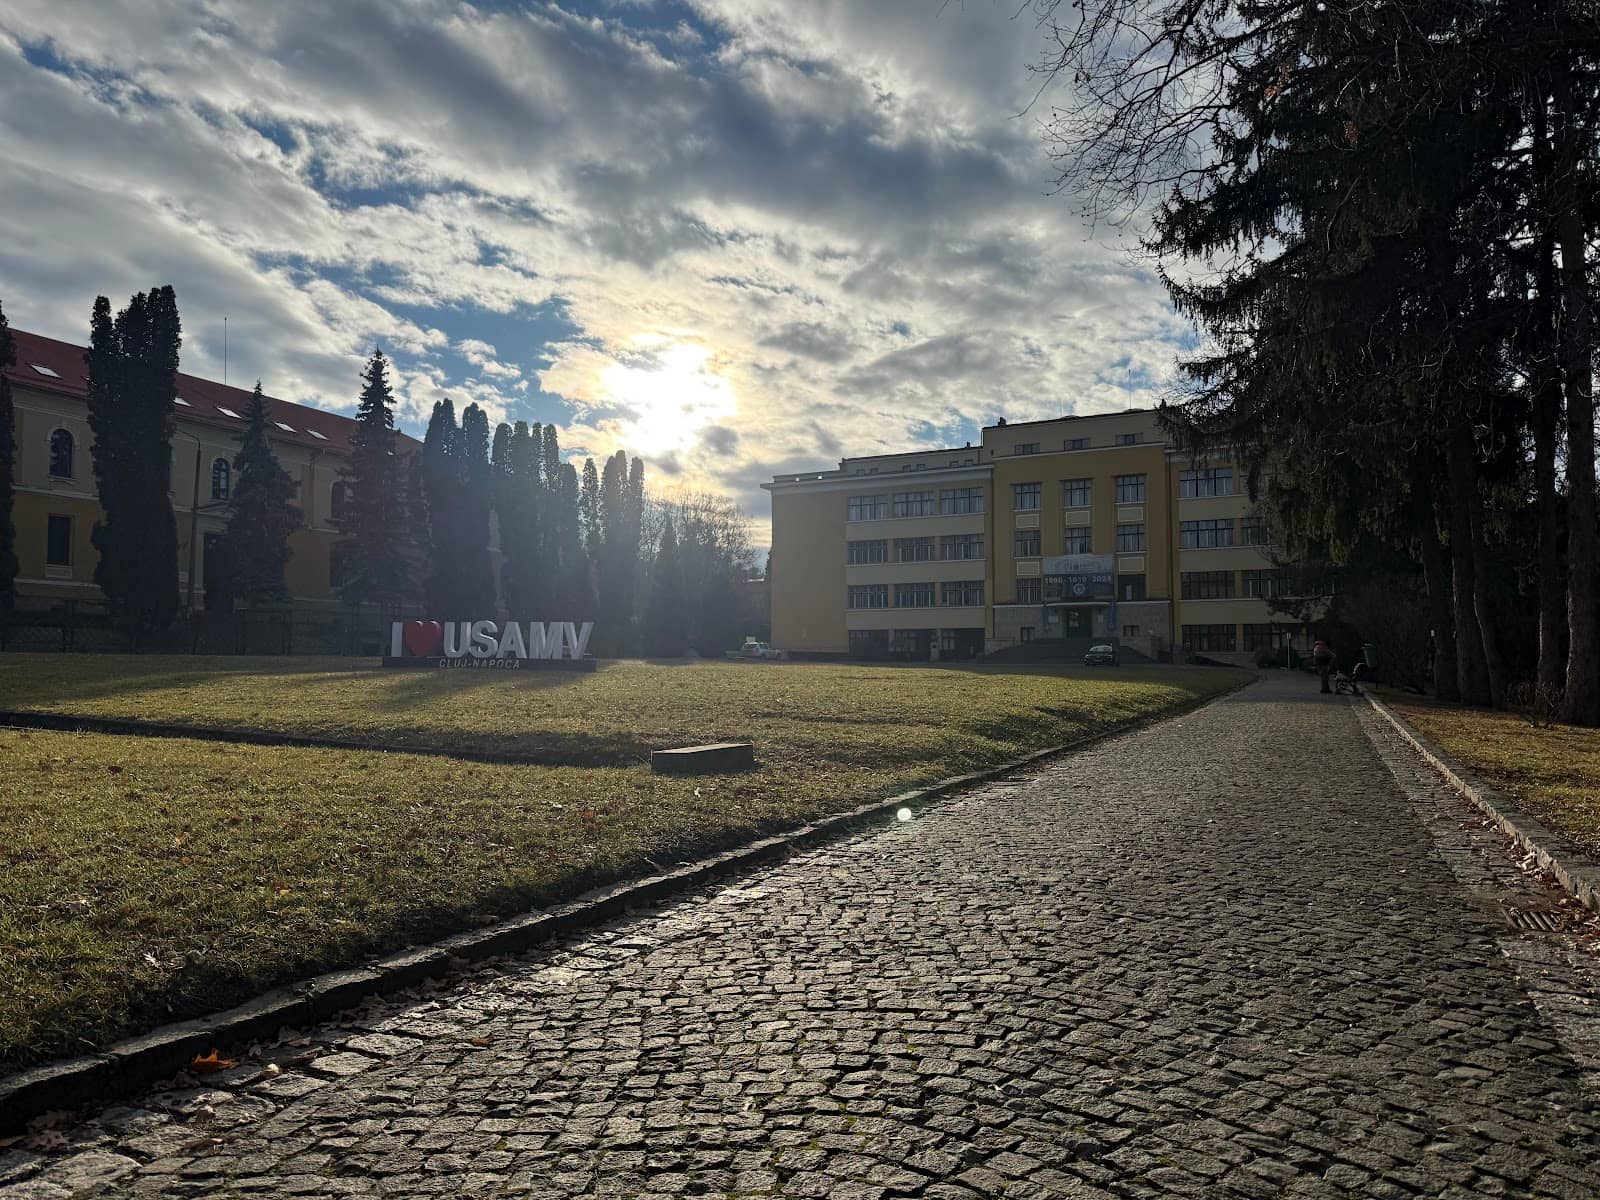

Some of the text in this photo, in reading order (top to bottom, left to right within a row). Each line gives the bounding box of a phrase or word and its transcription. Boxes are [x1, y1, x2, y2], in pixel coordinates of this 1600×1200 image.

[391, 620, 594, 659] I USAMV
[439, 659, 521, 669] CLUJ-NAPOCA
